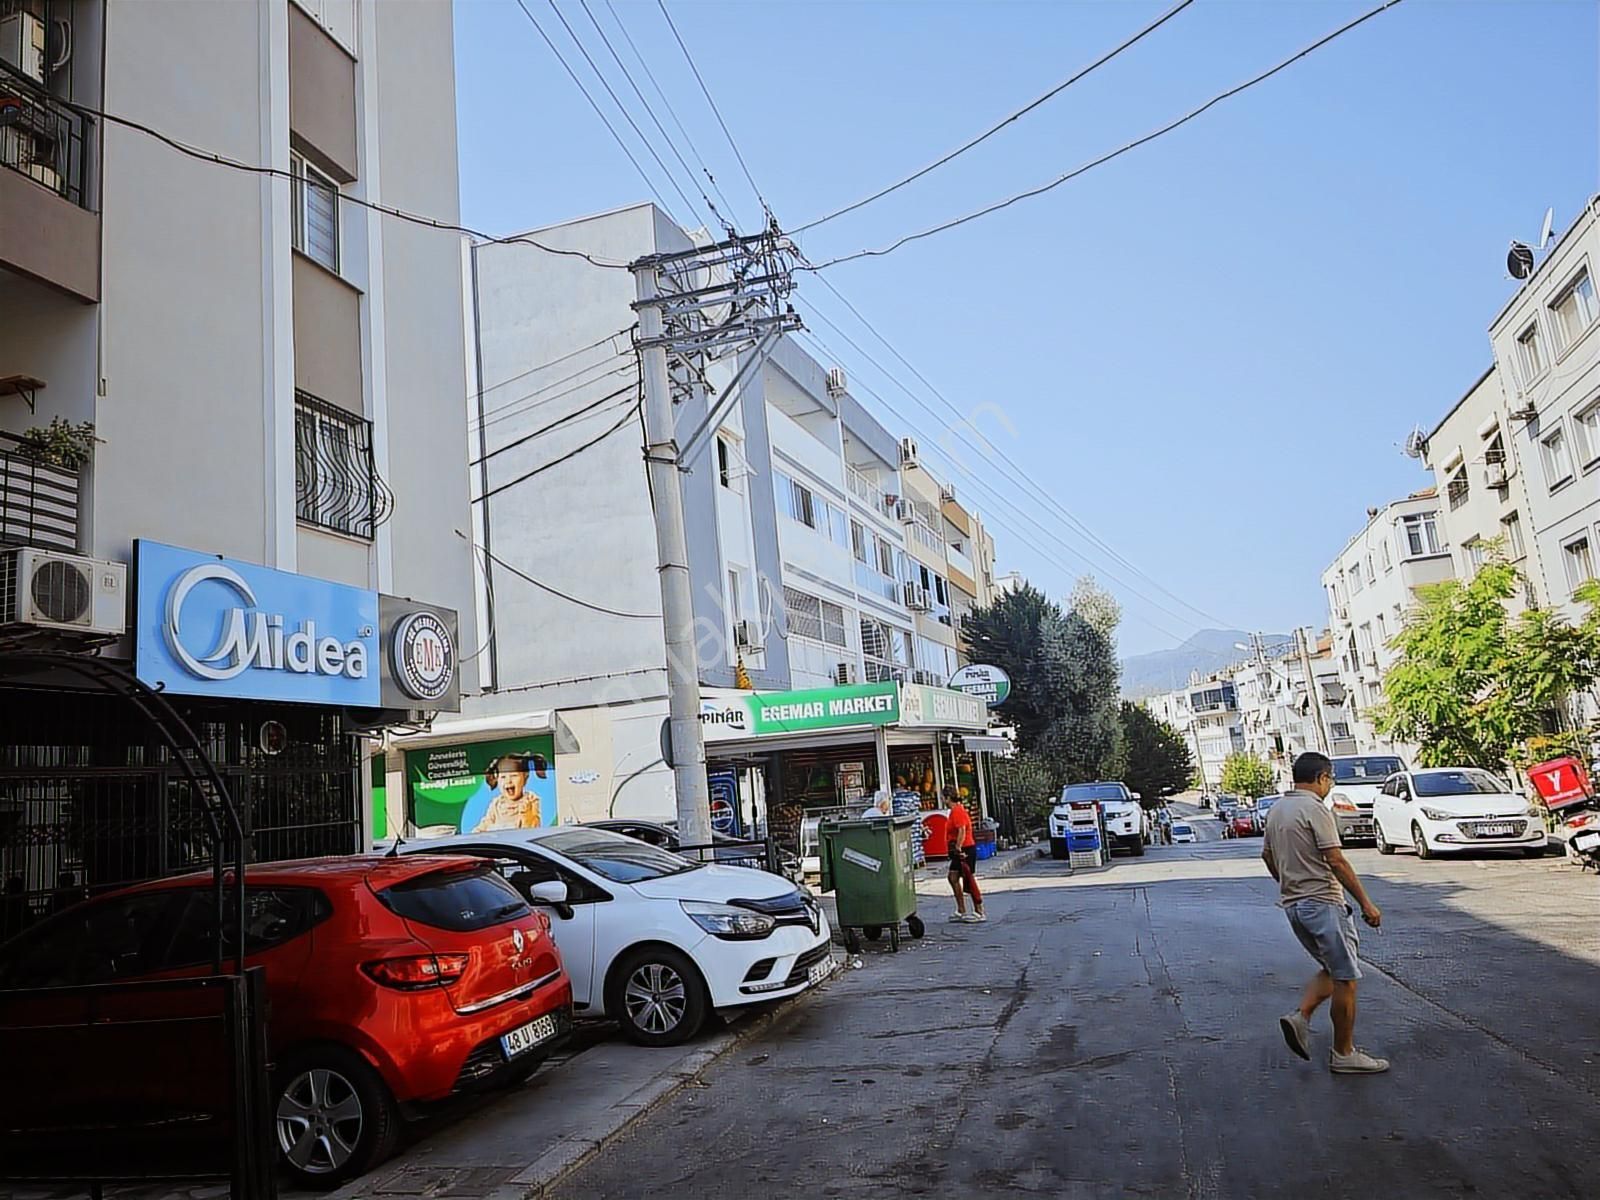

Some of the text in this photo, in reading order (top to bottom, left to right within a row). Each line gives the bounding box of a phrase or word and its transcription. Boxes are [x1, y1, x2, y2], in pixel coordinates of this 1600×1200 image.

[761, 694, 894, 722] EGEMAR MARKET
[1544, 769, 1561, 792] Y
[508, 1033, 522, 1051] 48
[521, 1029, 530, 1044] U
